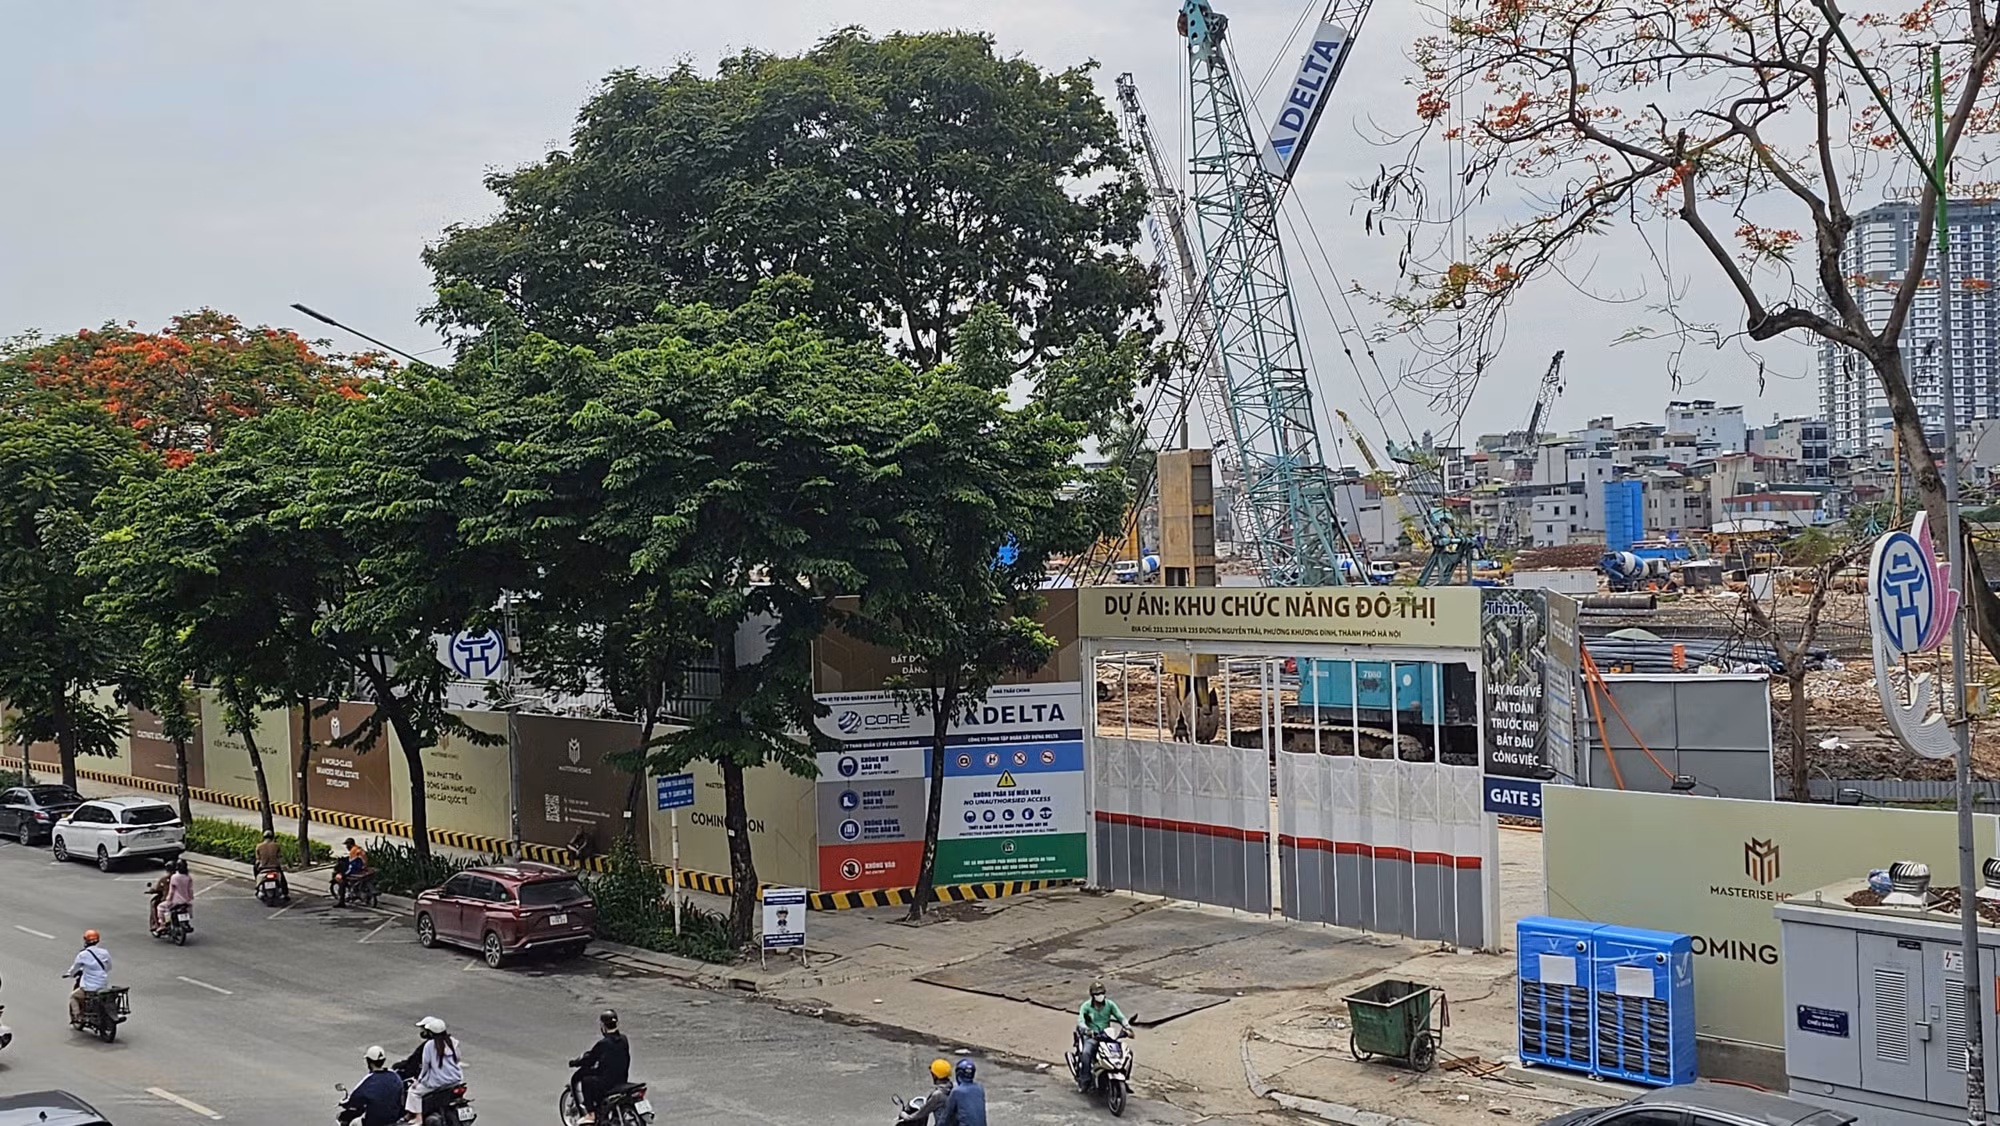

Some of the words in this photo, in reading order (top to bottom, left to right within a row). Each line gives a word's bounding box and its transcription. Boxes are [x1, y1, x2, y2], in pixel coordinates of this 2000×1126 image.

[1279, 41, 1340, 132] DELTA
[1105, 592, 1133, 622] DỰ
[1137, 592, 1170, 616] ÁN:
[1174, 596, 1216, 616] KHU
[1222, 592, 1280, 616] CHỨC
[1286, 592, 1350, 617] NĂNG
[1356, 592, 1392, 618] ĐÔ
[1396, 596, 1435, 626] THỊ
[1378, 629, 1387, 637] HÀ
[1389, 630, 1401, 638] NỘI
[983, 703, 1065, 724] DELTA
[1495, 701, 1508, 713] AN
[1509, 700, 1534, 714] TOÀN
[865, 714, 910, 725] CORE
[1491, 718, 1521, 730] TRƯỚC
[1523, 720, 1539, 731] KHI
[1492, 750, 1518, 763] CÔNG
[1519, 753, 1539, 768] VIỆC
[1490, 788, 1528, 806] GATE
[1532, 793, 1540, 807] 5
[691, 812, 726, 828] COMIN
[748, 819, 764, 833] ON
[1710, 886, 1774, 900] MASTERISE
[1690, 935, 1778, 965] OMING
